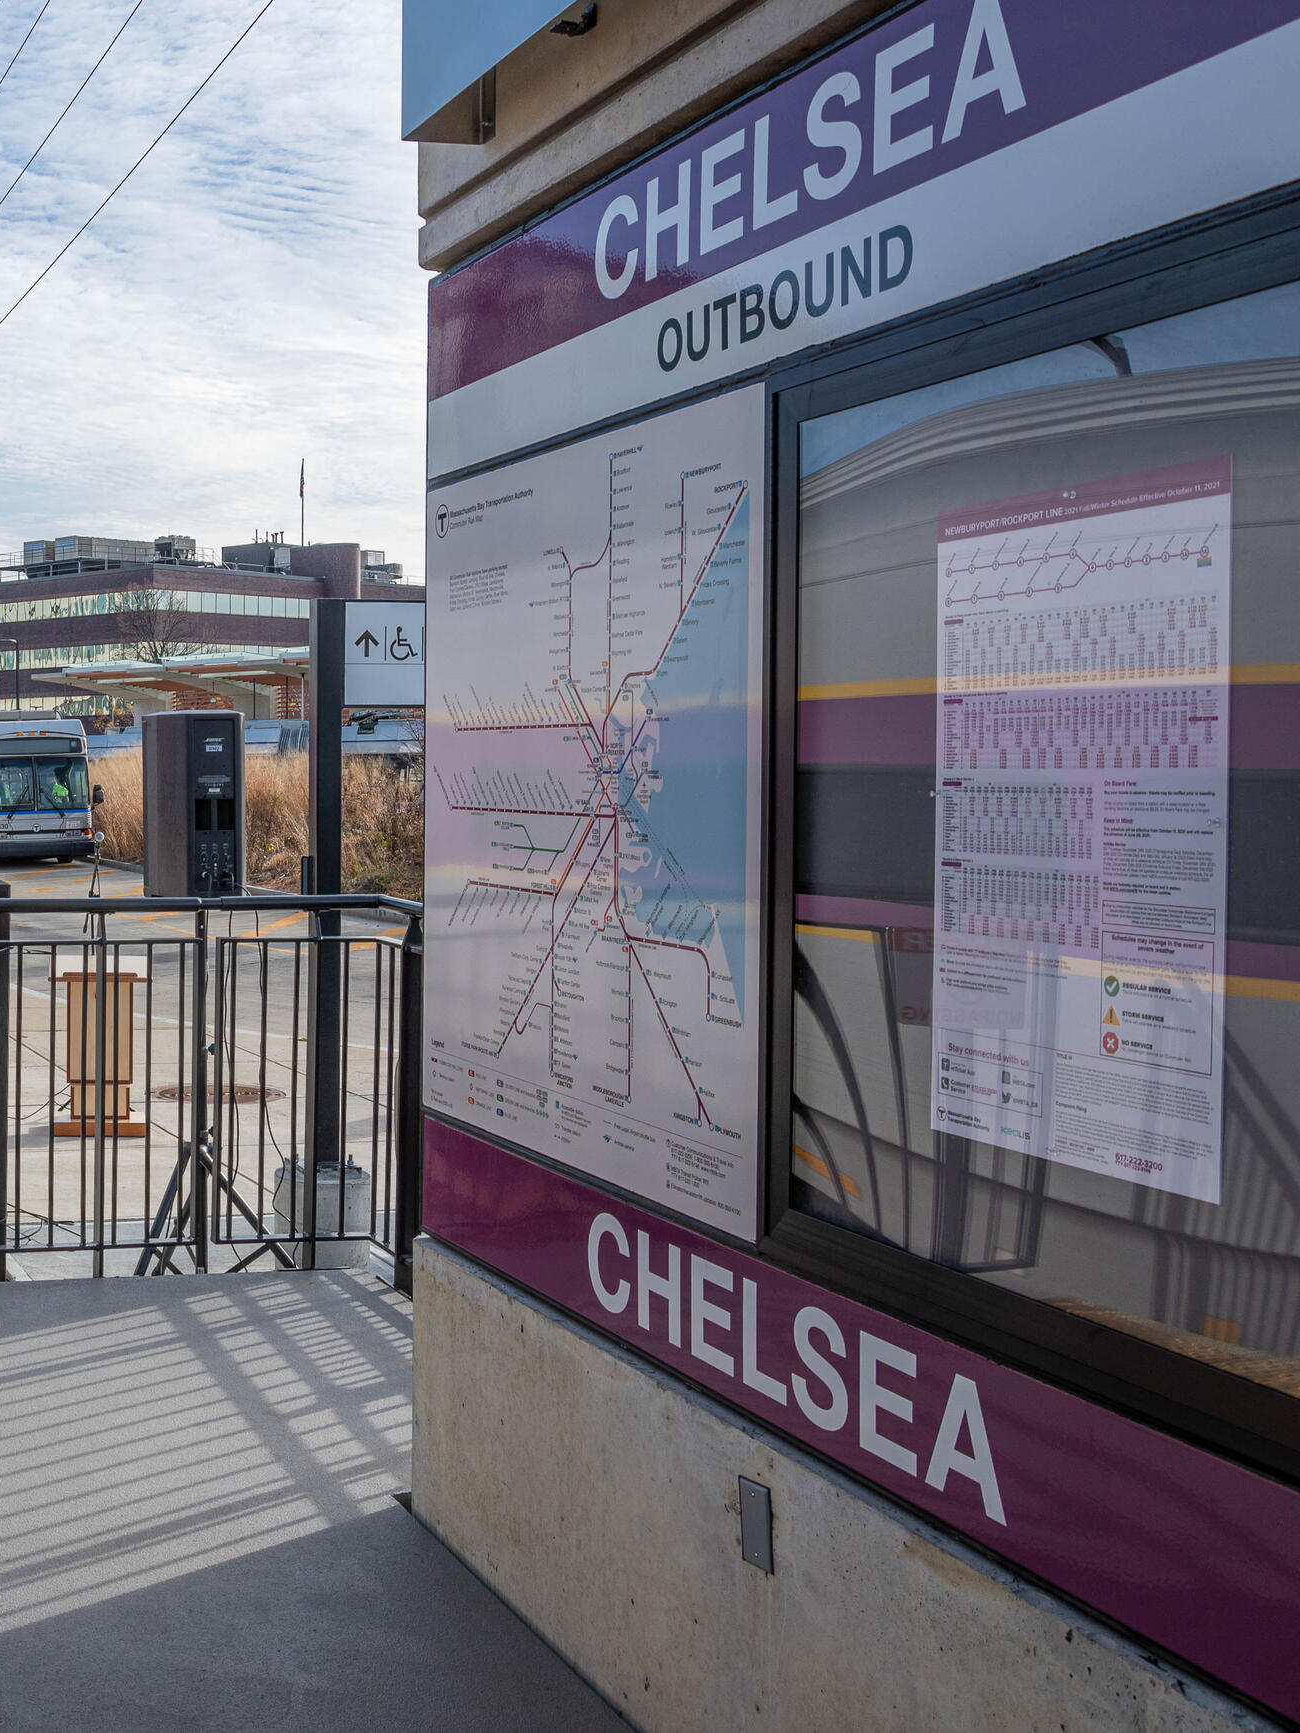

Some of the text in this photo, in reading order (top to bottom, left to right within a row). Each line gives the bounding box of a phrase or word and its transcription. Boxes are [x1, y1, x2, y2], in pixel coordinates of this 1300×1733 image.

[594, 0, 1027, 300] CHELSEA
[657, 225, 913, 371] OUTBOUND
[714, 481, 738, 494] ROCKPORT
[486, 494, 514, 508] Transportation
[514, 488, 533, 500] Authority
[945, 510, 1045, 536] NEWBURYPORT/ROCKPORT
[1045, 507, 1064, 518] LINE
[1204, 481, 1220, 490] 2021
[1112, 934, 1136, 942] Schedules
[1148, 938, 1166, 947] change
[1122, 983, 1171, 995] REGULAR SERVICE
[1122, 1011, 1164, 1023] STORM SERVICE
[431, 1038, 444, 1048] Legend
[1131, 1041, 1153, 1050] SERVICE
[948, 1042, 963, 1054] Stay
[965, 1048, 1001, 1061] connected
[1003, 1055, 1018, 1064] with
[951, 1080, 970, 1088] Customer
[948, 1110, 973, 1120] Massachusetts
[948, 1116, 972, 1127] Transportation
[1115, 1152, 1163, 1171] 617-222-3200
[587, 1212, 1007, 1527] CHELSEA
